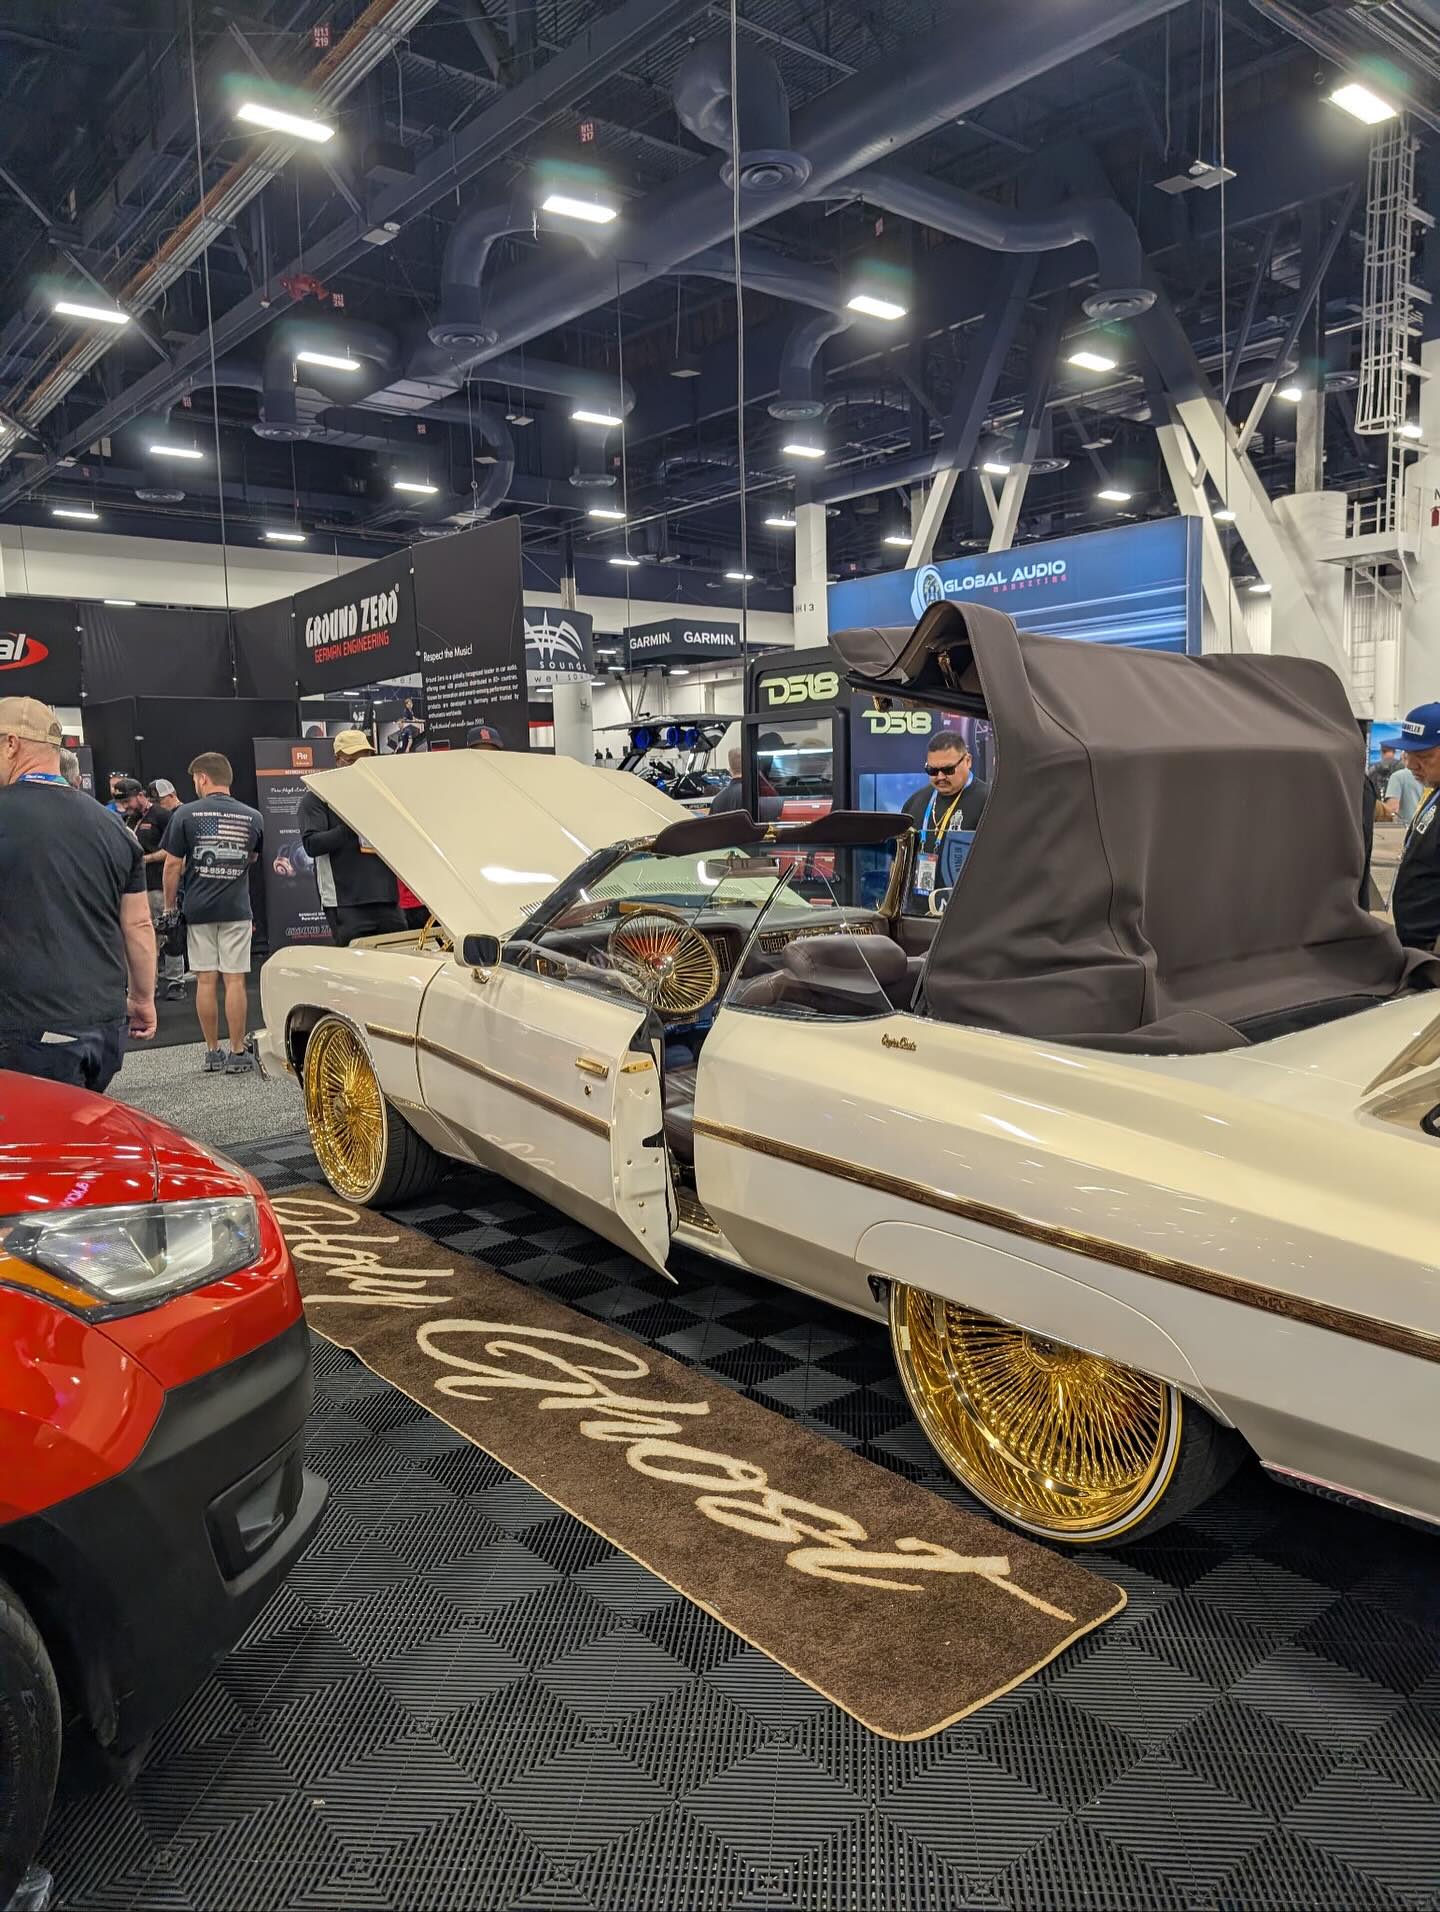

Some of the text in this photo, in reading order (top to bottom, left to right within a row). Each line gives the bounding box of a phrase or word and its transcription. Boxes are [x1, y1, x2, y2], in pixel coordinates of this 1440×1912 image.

[944, 560, 1067, 593] GLOBAL AUDIO
[992, 575, 1068, 593] MARKETING
[305, 603, 358, 648] GROUND
[314, 630, 390, 664] GERMAN ENGINEERING
[423, 643, 473, 664] Respect the Music!
[540, 660, 587, 671] sounds
[534, 673, 559, 683] wet
[760, 671, 839, 706] DS18
[861, 709, 933, 735] DS18
[296, 752, 308, 761] Re
[223, 812, 253, 822] AUTHORITY
[268, 1197, 1077, 1622] Holy Ghost
